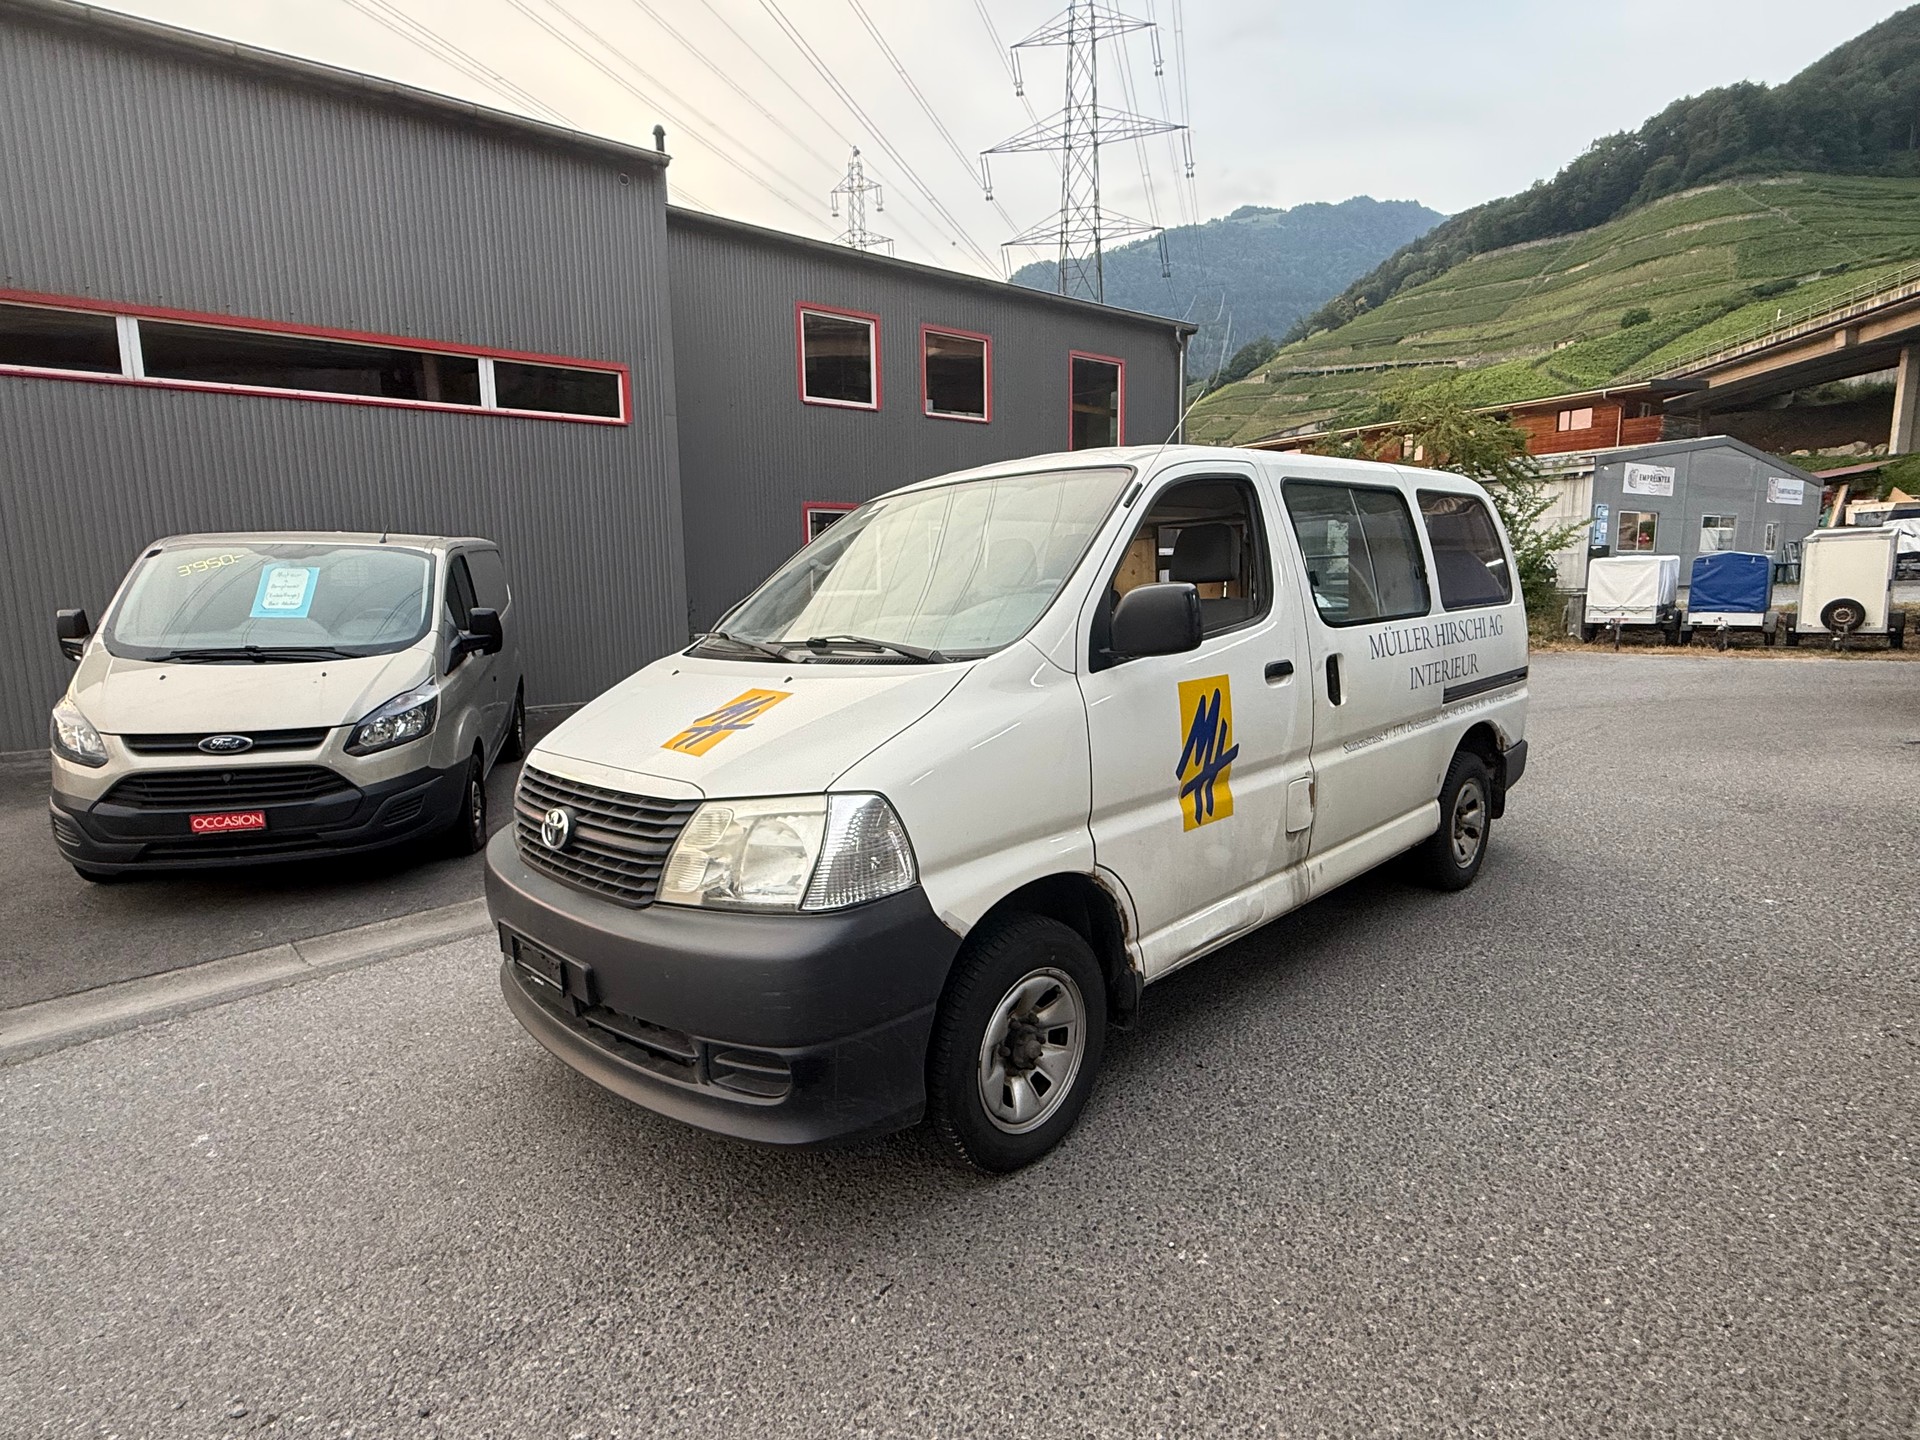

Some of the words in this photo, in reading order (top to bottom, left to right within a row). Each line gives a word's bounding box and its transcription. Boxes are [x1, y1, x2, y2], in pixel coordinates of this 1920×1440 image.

[1369, 626, 1434, 660] MÜLLER
[1434, 617, 1487, 647] HIRSCHI
[1489, 614, 1504, 637] AG
[1410, 653, 1479, 690] INTERIEUR
[210, 738, 240, 750] Ford
[193, 813, 263, 829] OCCASION
